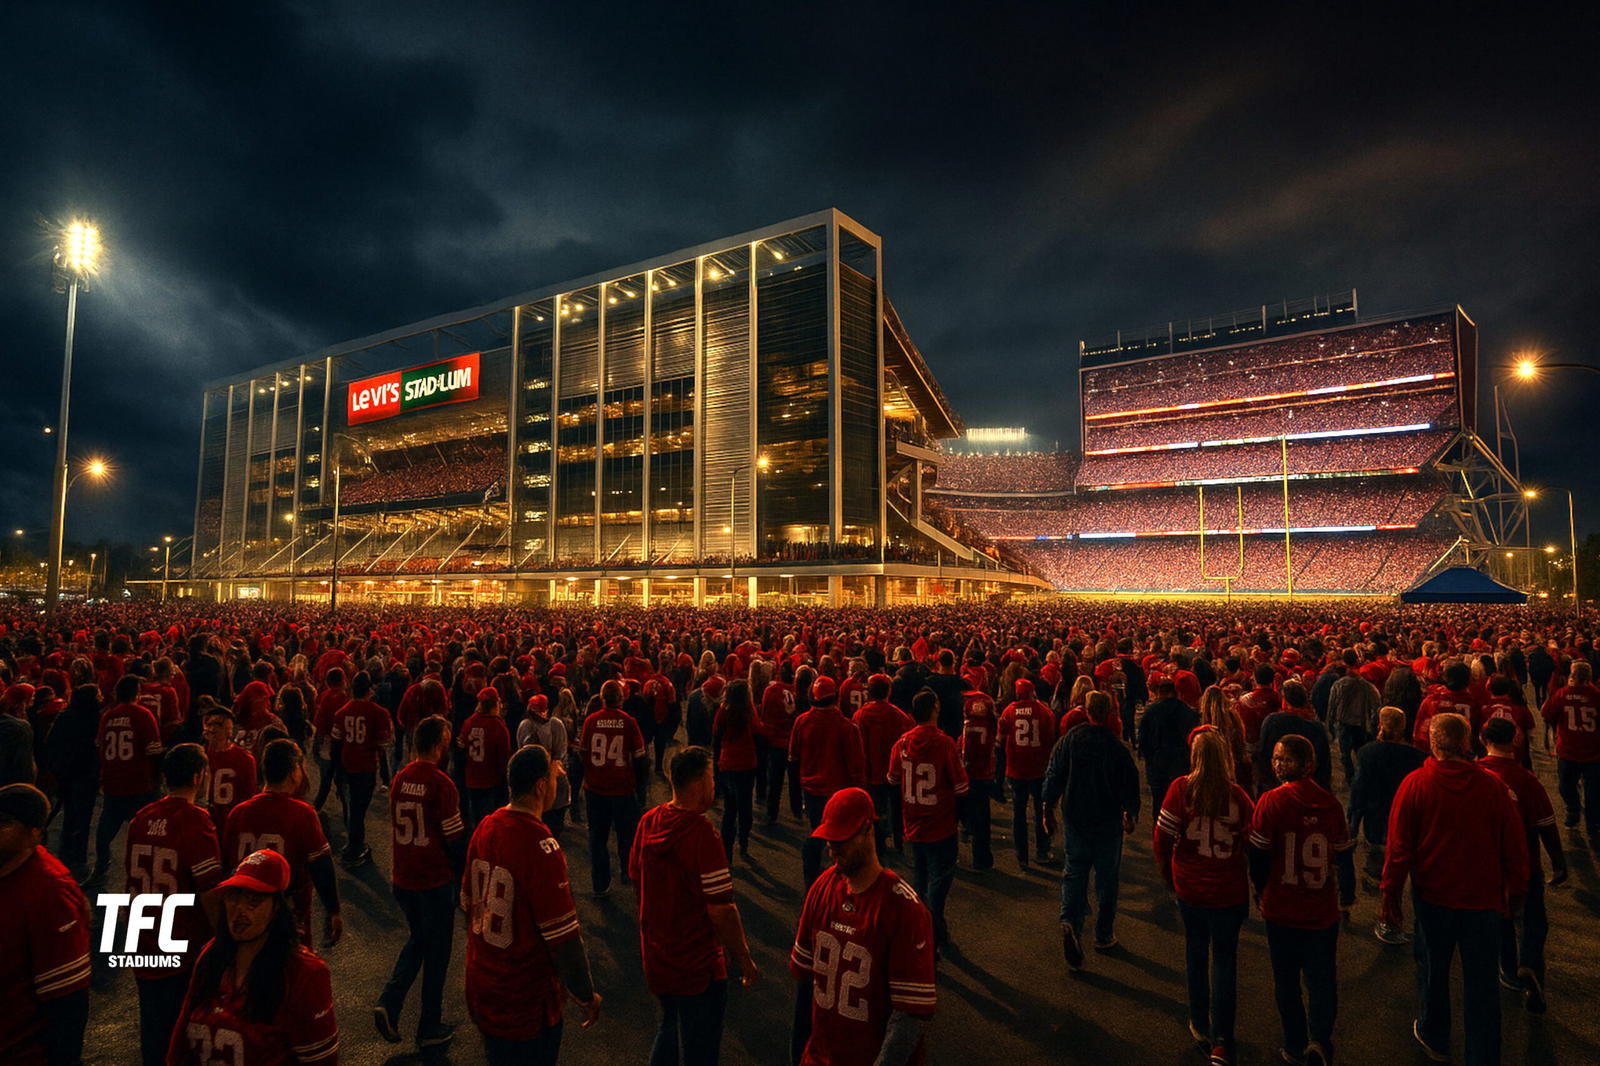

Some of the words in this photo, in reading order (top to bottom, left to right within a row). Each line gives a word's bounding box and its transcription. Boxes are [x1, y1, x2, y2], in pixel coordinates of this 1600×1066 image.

[591, 732, 626, 767] 94
[1015, 719, 1041, 748] 21
[901, 760, 938, 805] 12
[395, 801, 431, 847] 51
[1281, 832, 1329, 889] 19
[813, 930, 873, 1023] 92
